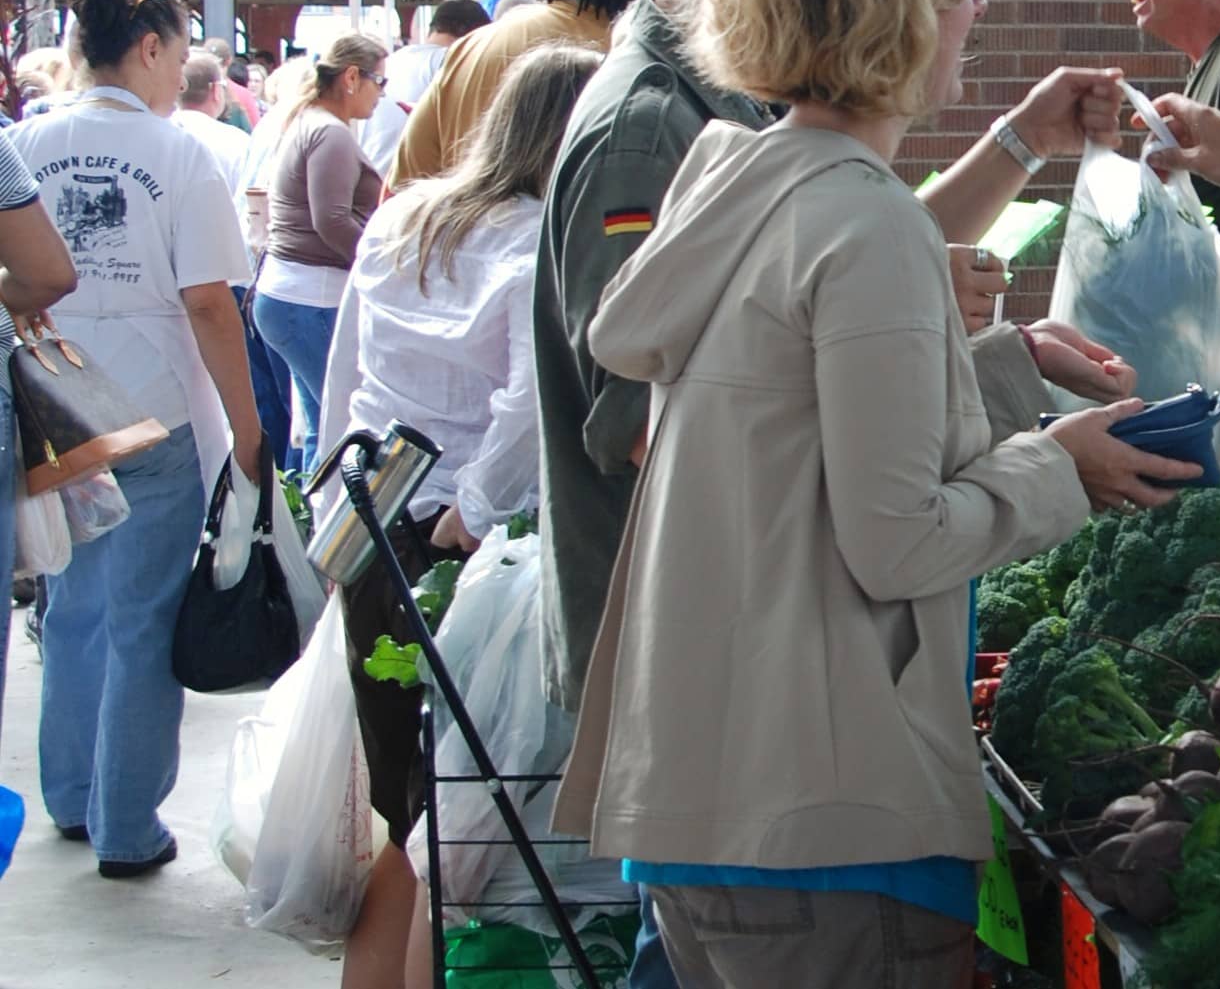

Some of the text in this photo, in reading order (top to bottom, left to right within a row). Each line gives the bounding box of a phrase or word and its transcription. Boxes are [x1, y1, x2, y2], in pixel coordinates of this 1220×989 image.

[35, 155, 164, 202] OTOWN CAFE & GRILL
